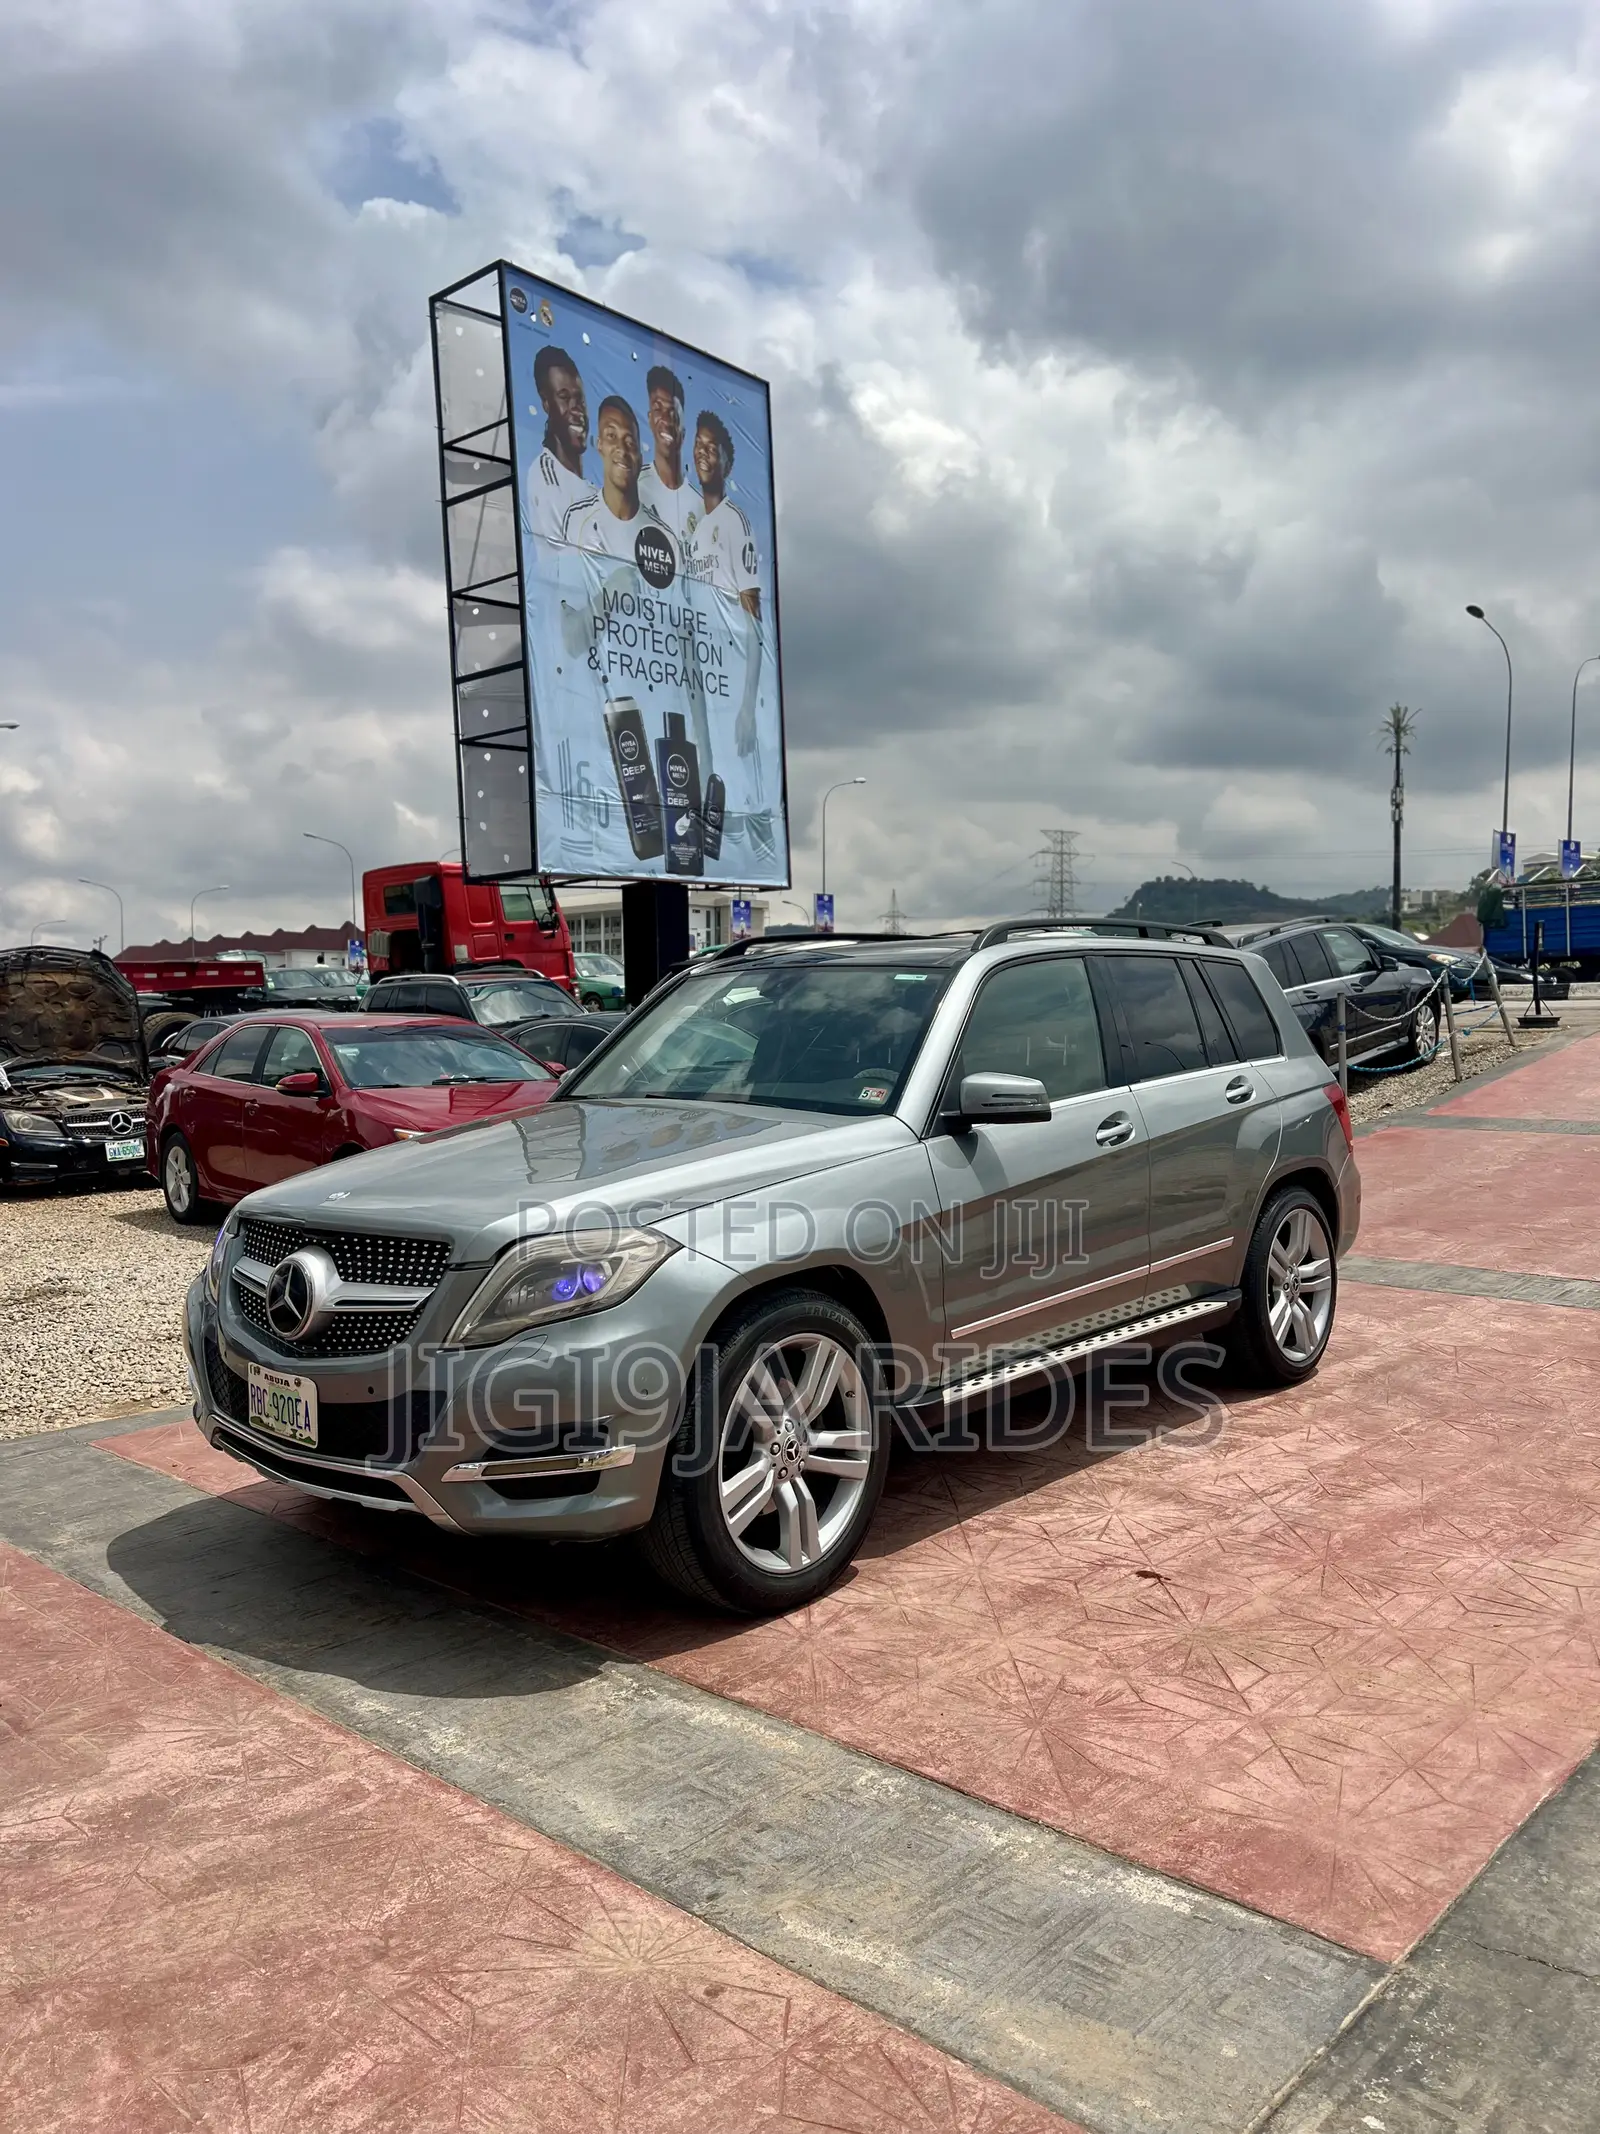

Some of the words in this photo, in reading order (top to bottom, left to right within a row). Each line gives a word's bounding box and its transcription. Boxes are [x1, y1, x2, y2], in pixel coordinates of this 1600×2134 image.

[638, 544, 673, 565] NIVEA
[644, 560, 669, 576] MEN
[602, 587, 713, 640] MOISTURE,
[593, 615, 723, 668] PROTECTION
[587, 646, 602, 671] &
[607, 650, 730, 698] FRAGRANCE
[622, 765, 646, 776] DEEP
[667, 797, 690, 807] DEEP
[264, 1373, 291, 1387] ABUJA
